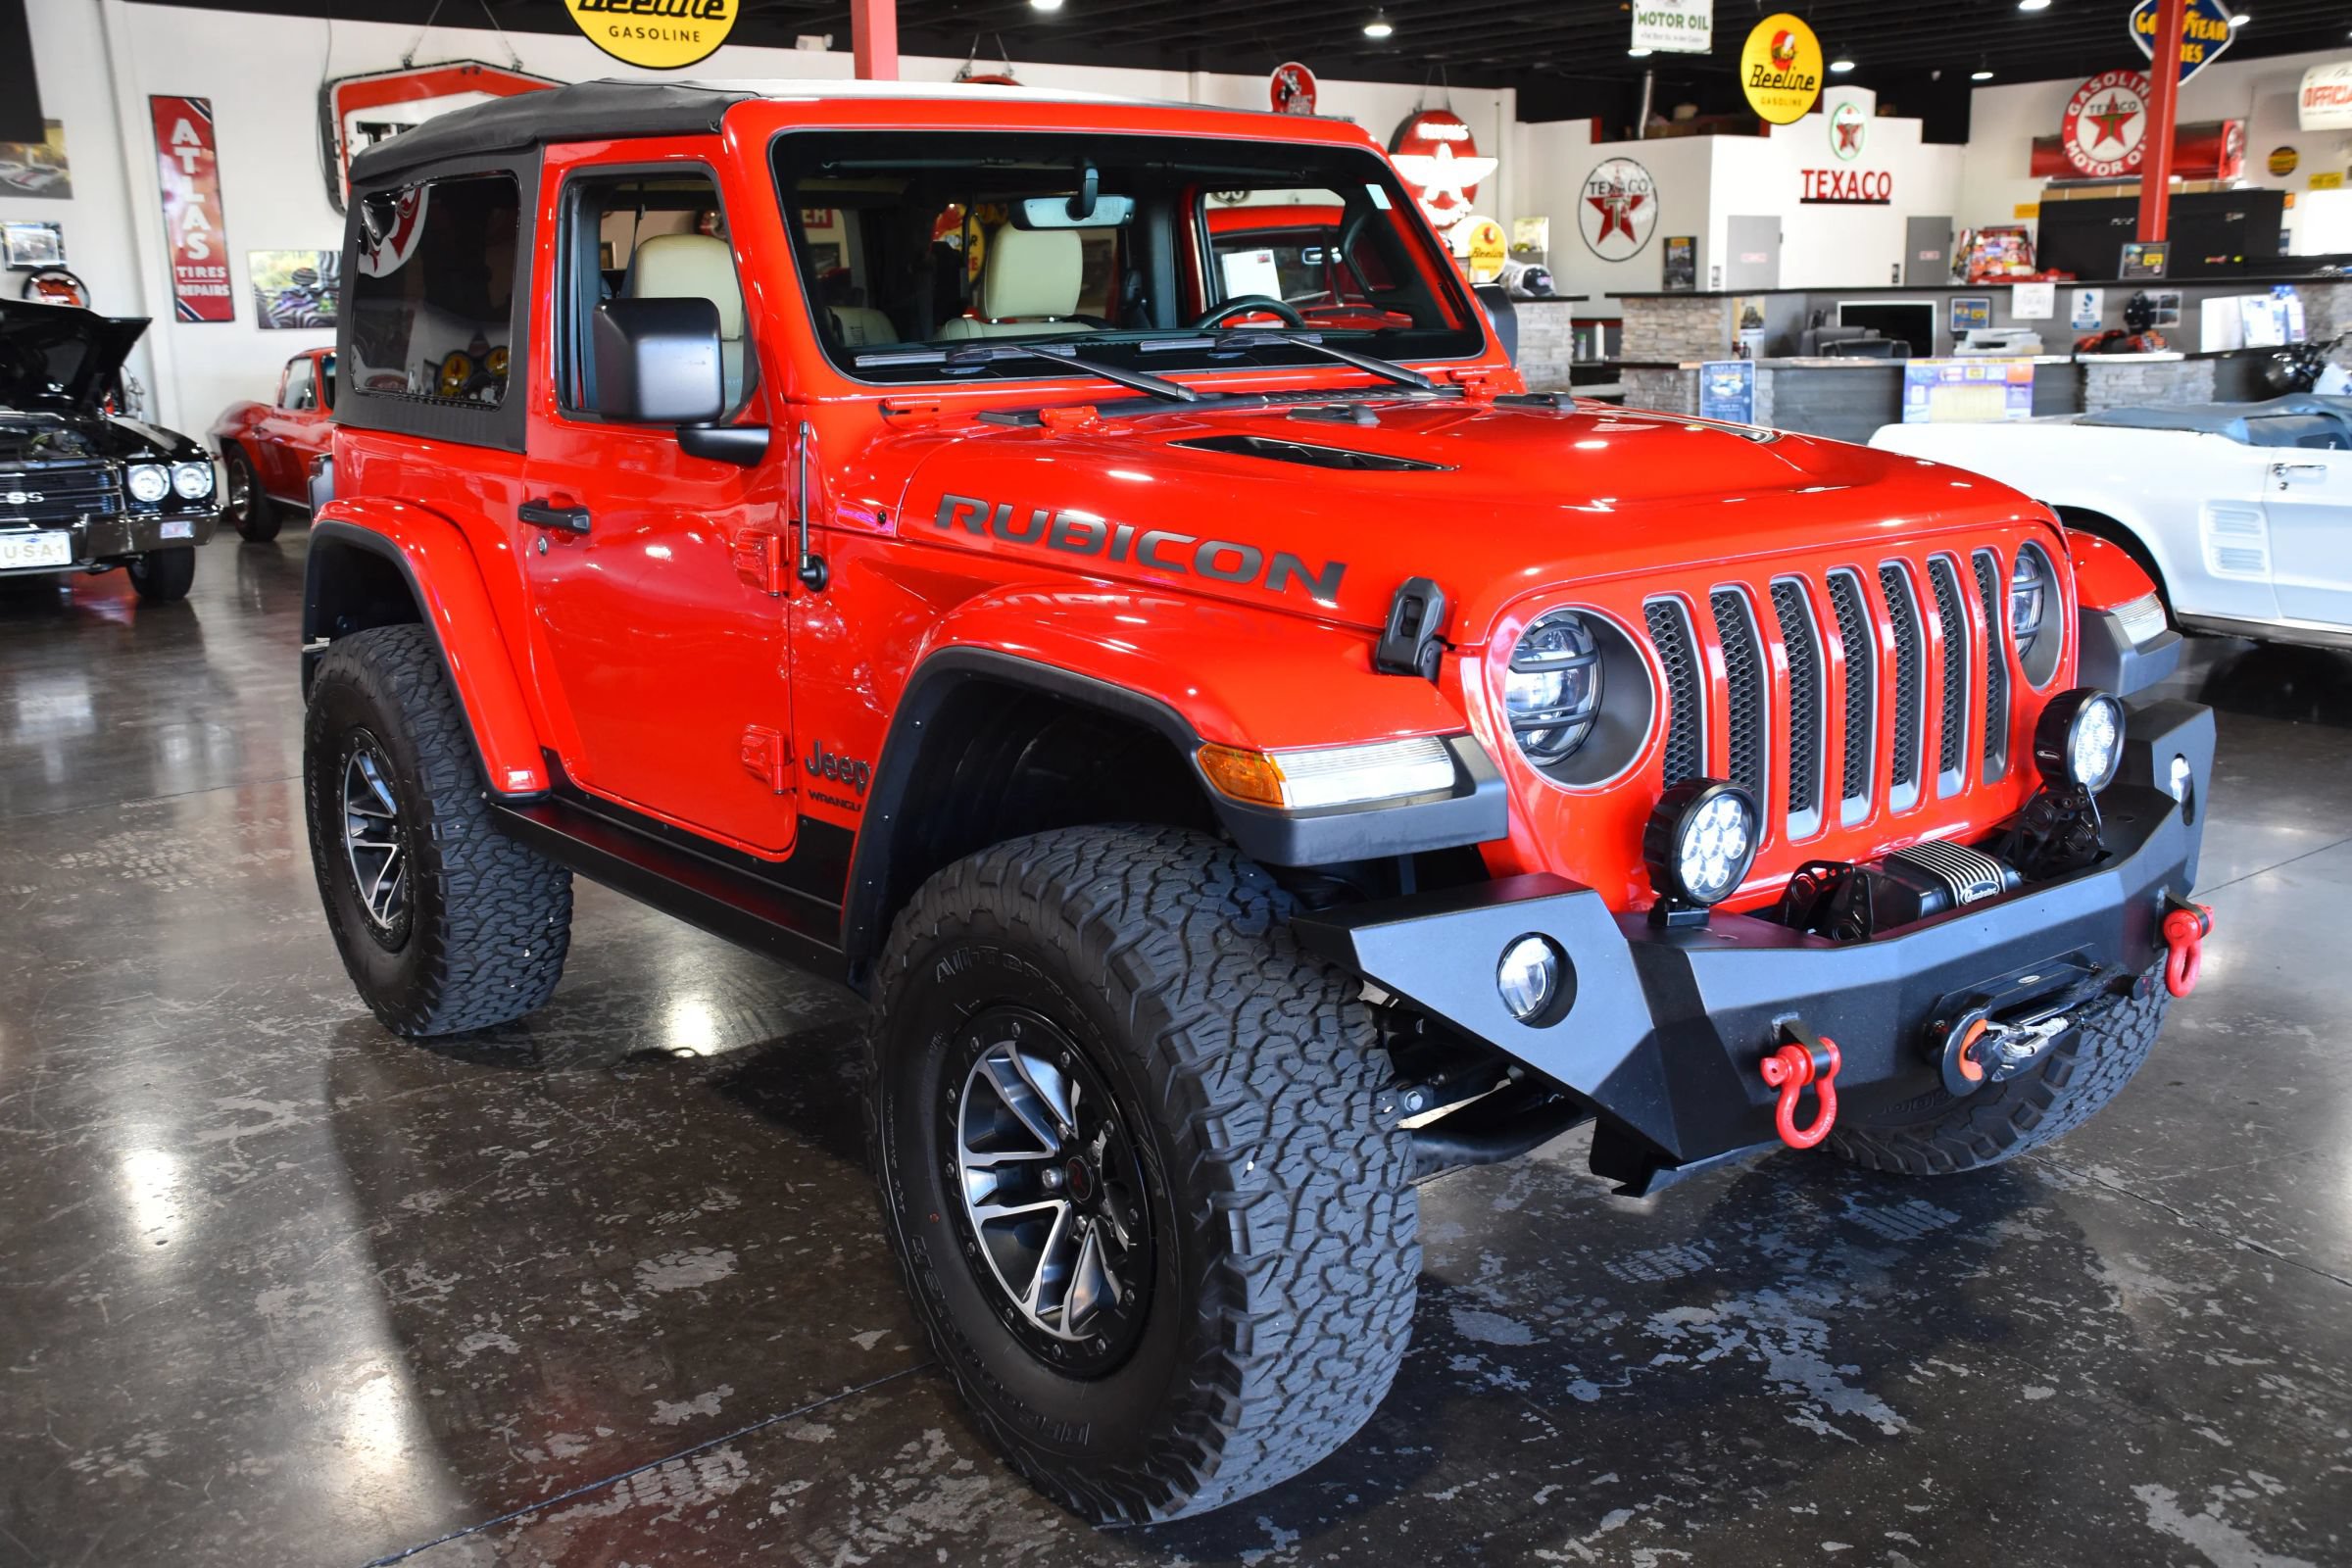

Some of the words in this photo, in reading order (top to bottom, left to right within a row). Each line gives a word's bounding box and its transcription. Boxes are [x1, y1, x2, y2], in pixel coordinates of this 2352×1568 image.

[1638, 12, 1684, 28] MOTOR
[1688, 15, 1708, 31] OIL
[609, 25, 701, 42] GASOLINE
[1749, 64, 1815, 91] Beeline
[2066, 139, 2124, 175] MOTOR
[171, 118, 213, 261] ATLAS
[1590, 178, 1648, 195] TEXACO
[1801, 170, 1891, 199] TEXACO
[177, 266, 226, 278] TIRES
[178, 283, 230, 296] REPAIRS
[7, 491, 45, 505] SS
[934, 492, 1348, 602] RUBICON
[806, 739, 870, 797] Jeep
